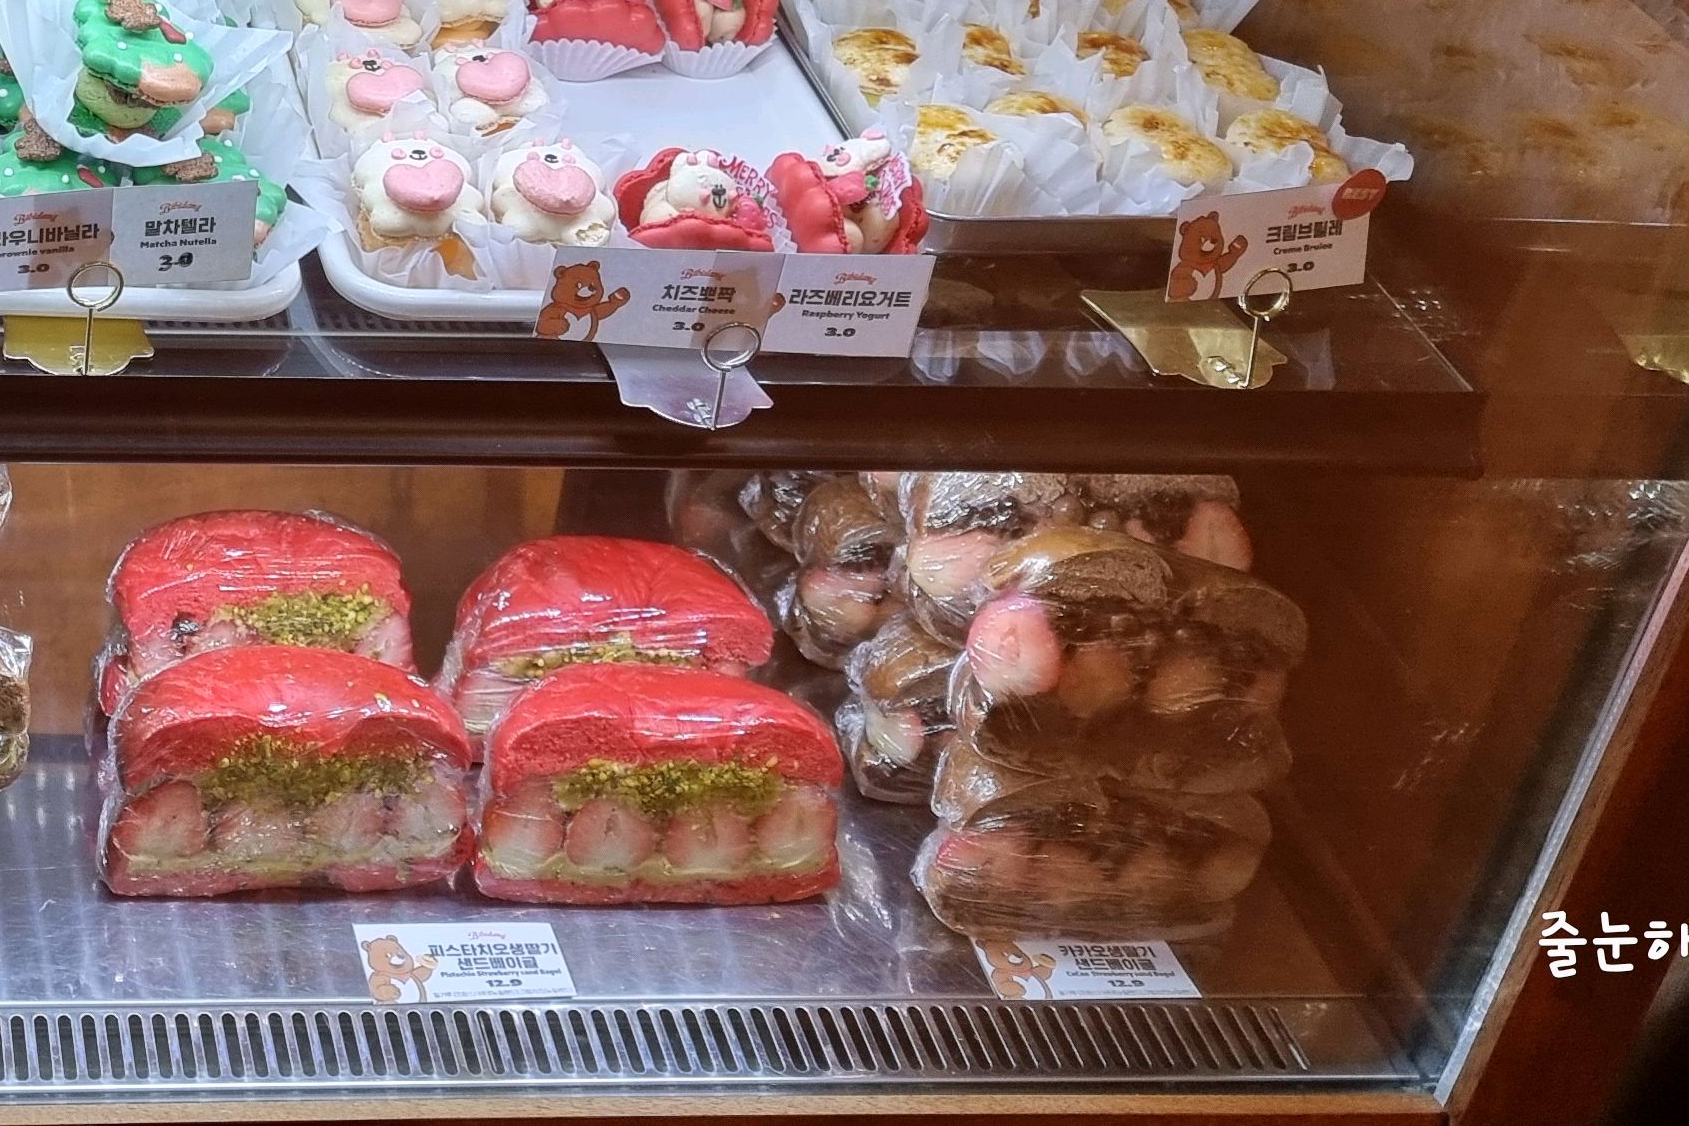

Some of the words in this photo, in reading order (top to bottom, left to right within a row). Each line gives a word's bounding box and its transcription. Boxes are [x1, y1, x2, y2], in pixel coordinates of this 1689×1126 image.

[145, 217, 217, 237] 말차텔라
[140, 240, 178, 249] Matcha
[179, 238, 217, 247] Nutella
[39, 245, 75, 255] vanilla
[17, 263, 51, 274] 3.0
[1287, 261, 1315, 273] 3.0
[788, 288, 912, 309] 라즈베리요거트
[652, 304, 697, 314] Cheddar
[698, 305, 736, 315] Cheese
[802, 309, 854, 320] Raspberry
[856, 311, 891, 321] Yogurt
[672, 321, 706, 333] 3.0
[824, 327, 857, 338] 3.0
[428, 943, 558, 957] 피스타치오생딸기
[1058, 945, 1156, 958] 카카오생딸기
[458, 956, 539, 970] 샌드베이글
[1074, 958, 1157, 971] 샌드베이글
[485, 979, 522, 987] 12.9
[1107, 979, 1145, 988] 12.9
